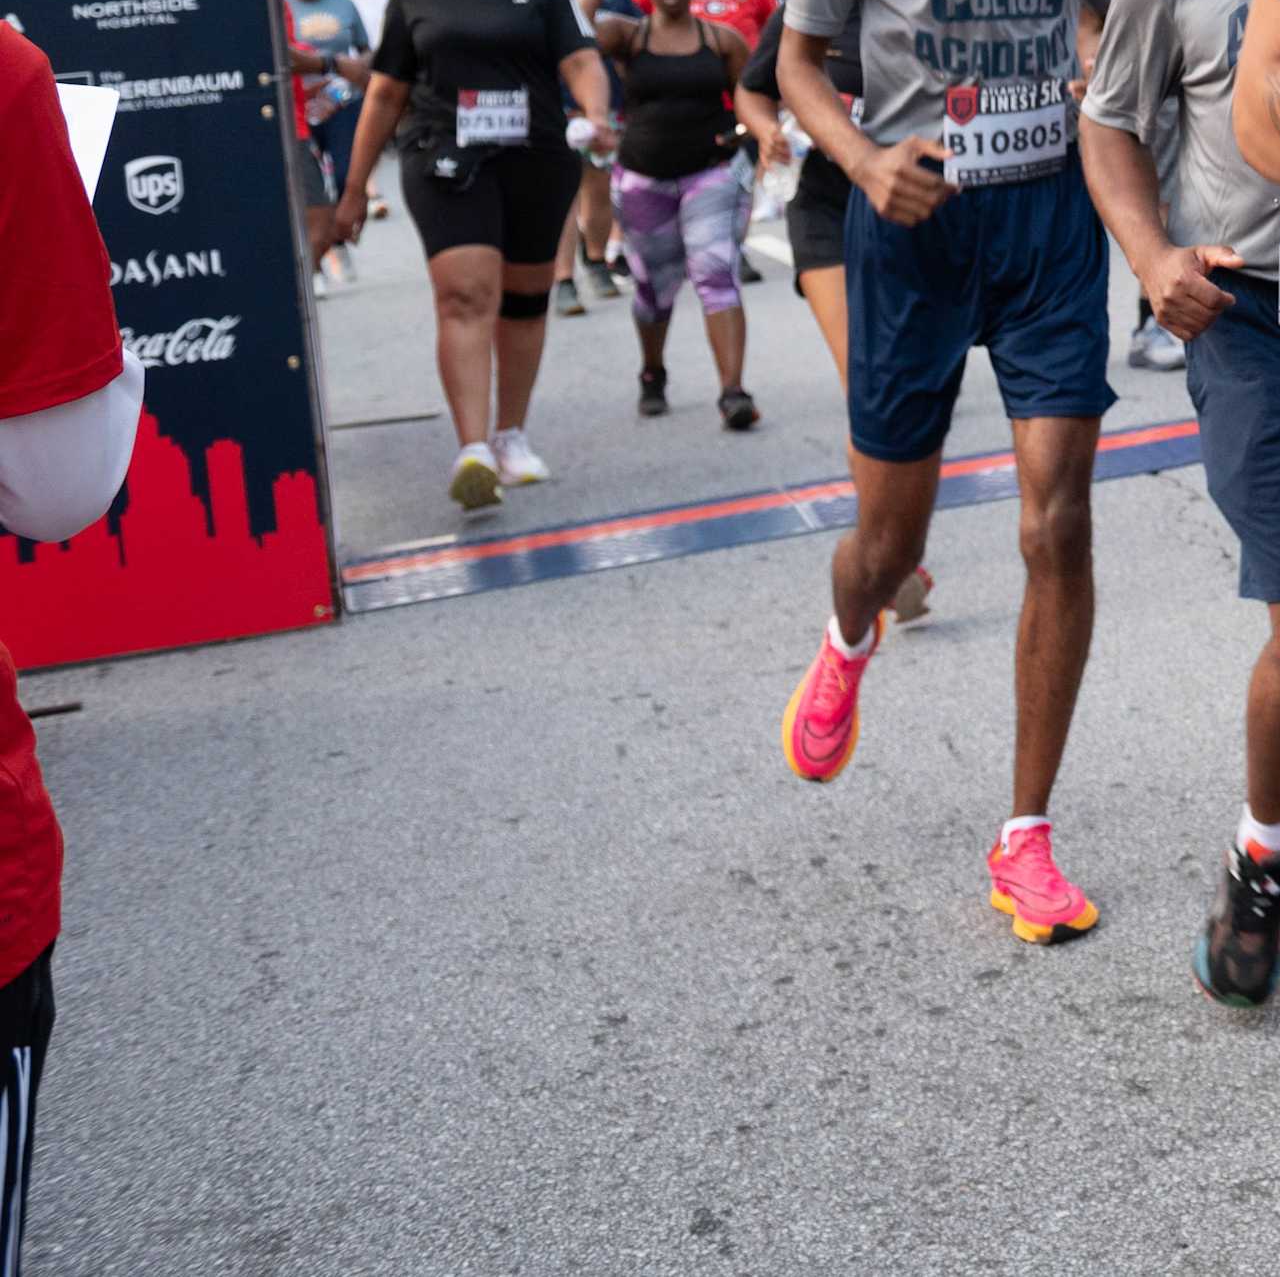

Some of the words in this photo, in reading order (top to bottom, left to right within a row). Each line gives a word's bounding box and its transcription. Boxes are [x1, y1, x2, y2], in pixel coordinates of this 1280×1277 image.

[97, 13, 179, 30] HOSPITAL
[914, 18, 1070, 79] ACADEMY
[145, 91, 223, 110] FOUNDATION
[981, 91, 1037, 113] FINEST
[1040, 77, 1063, 105] 5K
[949, 120, 1062, 157] B10805
[131, 171, 177, 207] ups
